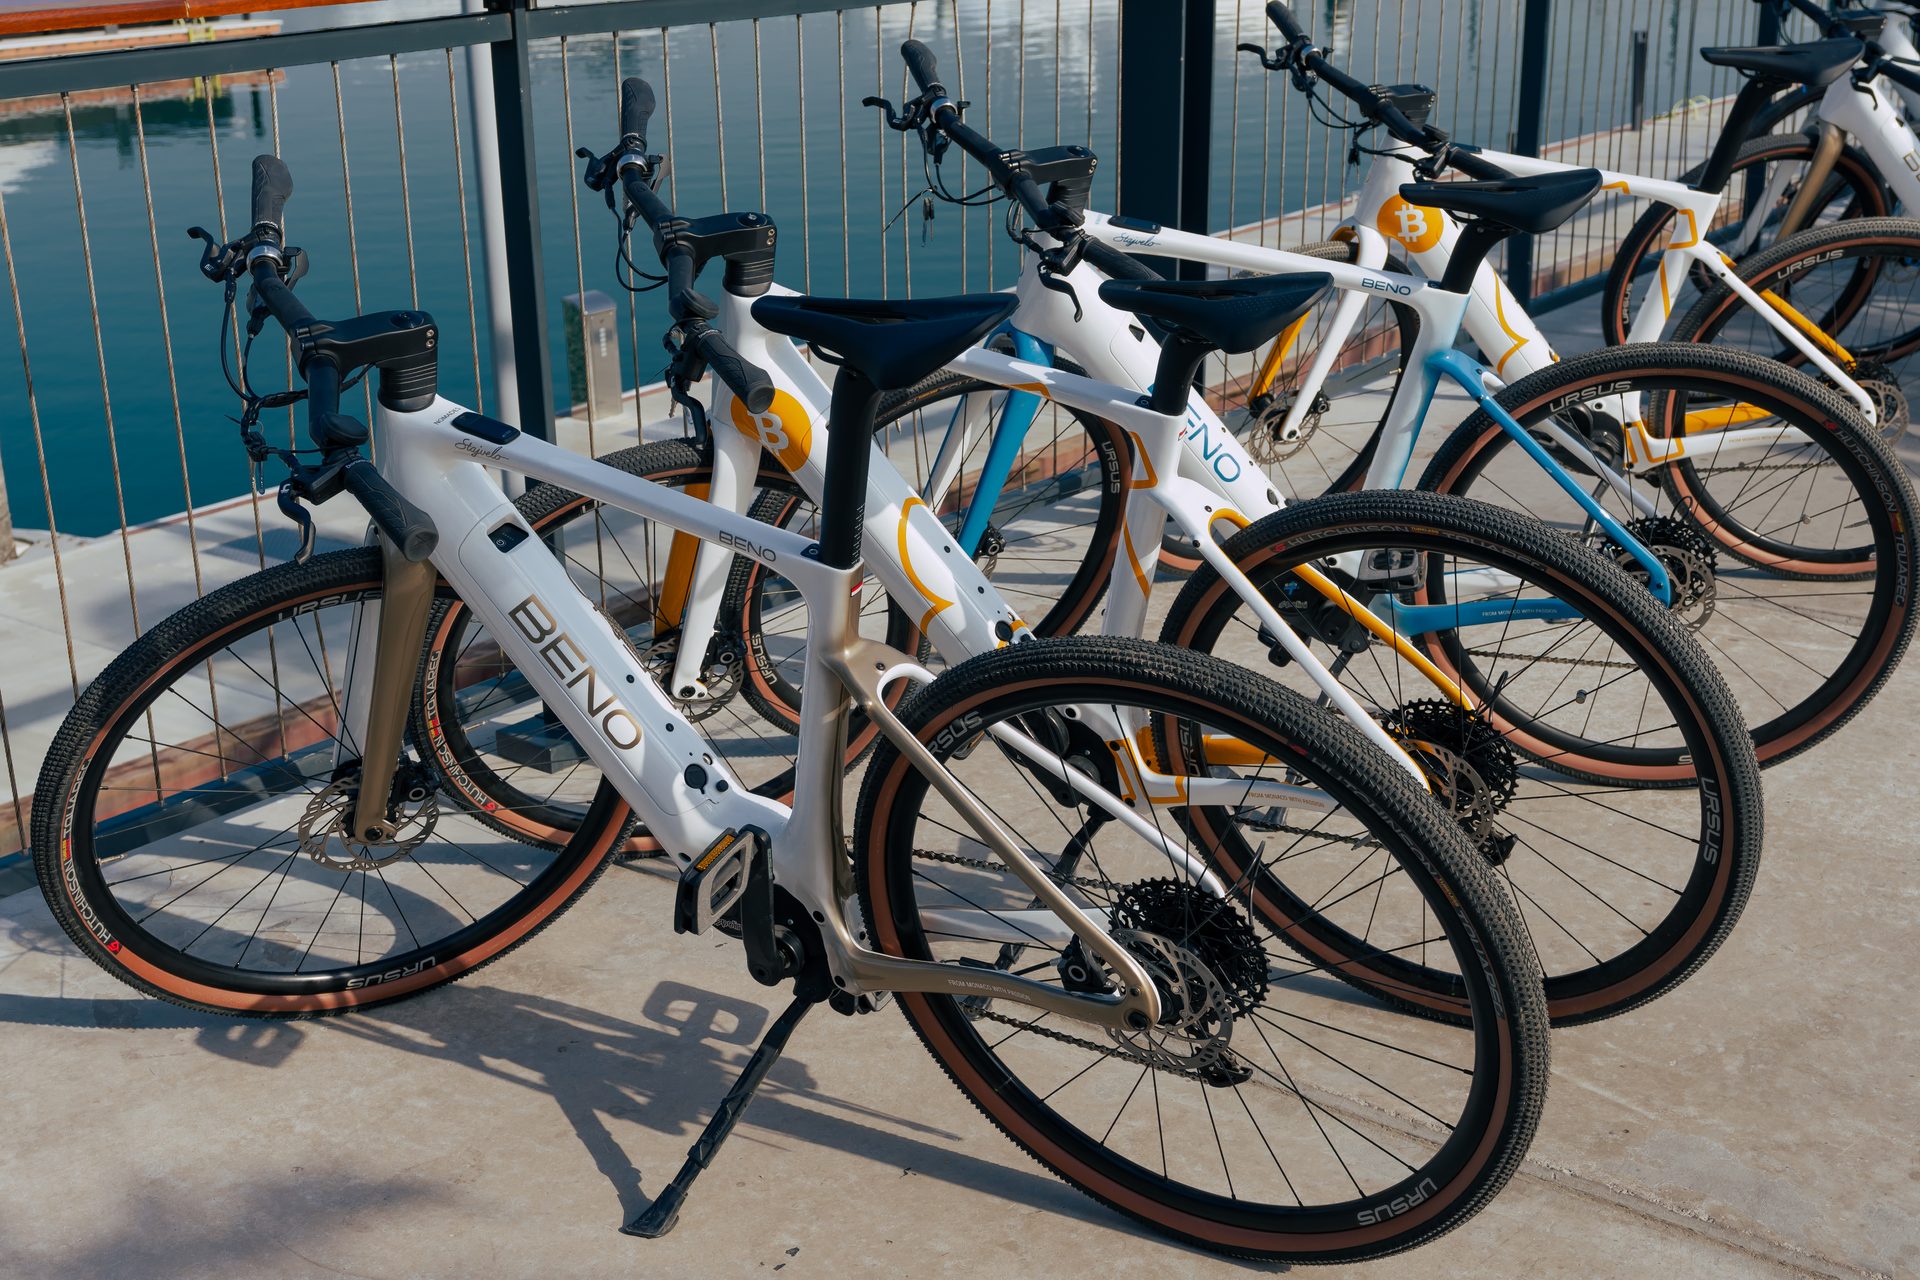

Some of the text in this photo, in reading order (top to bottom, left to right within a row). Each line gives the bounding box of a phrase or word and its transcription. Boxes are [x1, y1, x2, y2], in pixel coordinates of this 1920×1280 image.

[1362, 278, 1411, 295] BENO
[1777, 249, 1844, 279] URSUS
[1550, 381, 1632, 412] URSUS
[1185, 402, 1241, 482] NO
[1101, 441, 1120, 493] URSUS
[1836, 430, 1896, 512] HUTCHINSON
[719, 530, 776, 562] BENO
[1287, 525, 1410, 548] HUTCHINSON
[278, 590, 382, 621] URSUS
[508, 594, 642, 750] BENO
[752, 634, 777, 685] URSUS
[927, 711, 982, 754] RSUS
[433, 737, 487, 805] HUTCHINSON
[1701, 777, 1720, 865] URSUS
[64, 857, 112, 945] HUTCHINSON
[345, 956, 436, 989] URSUS
[1357, 1177, 1438, 1225] URSUS
